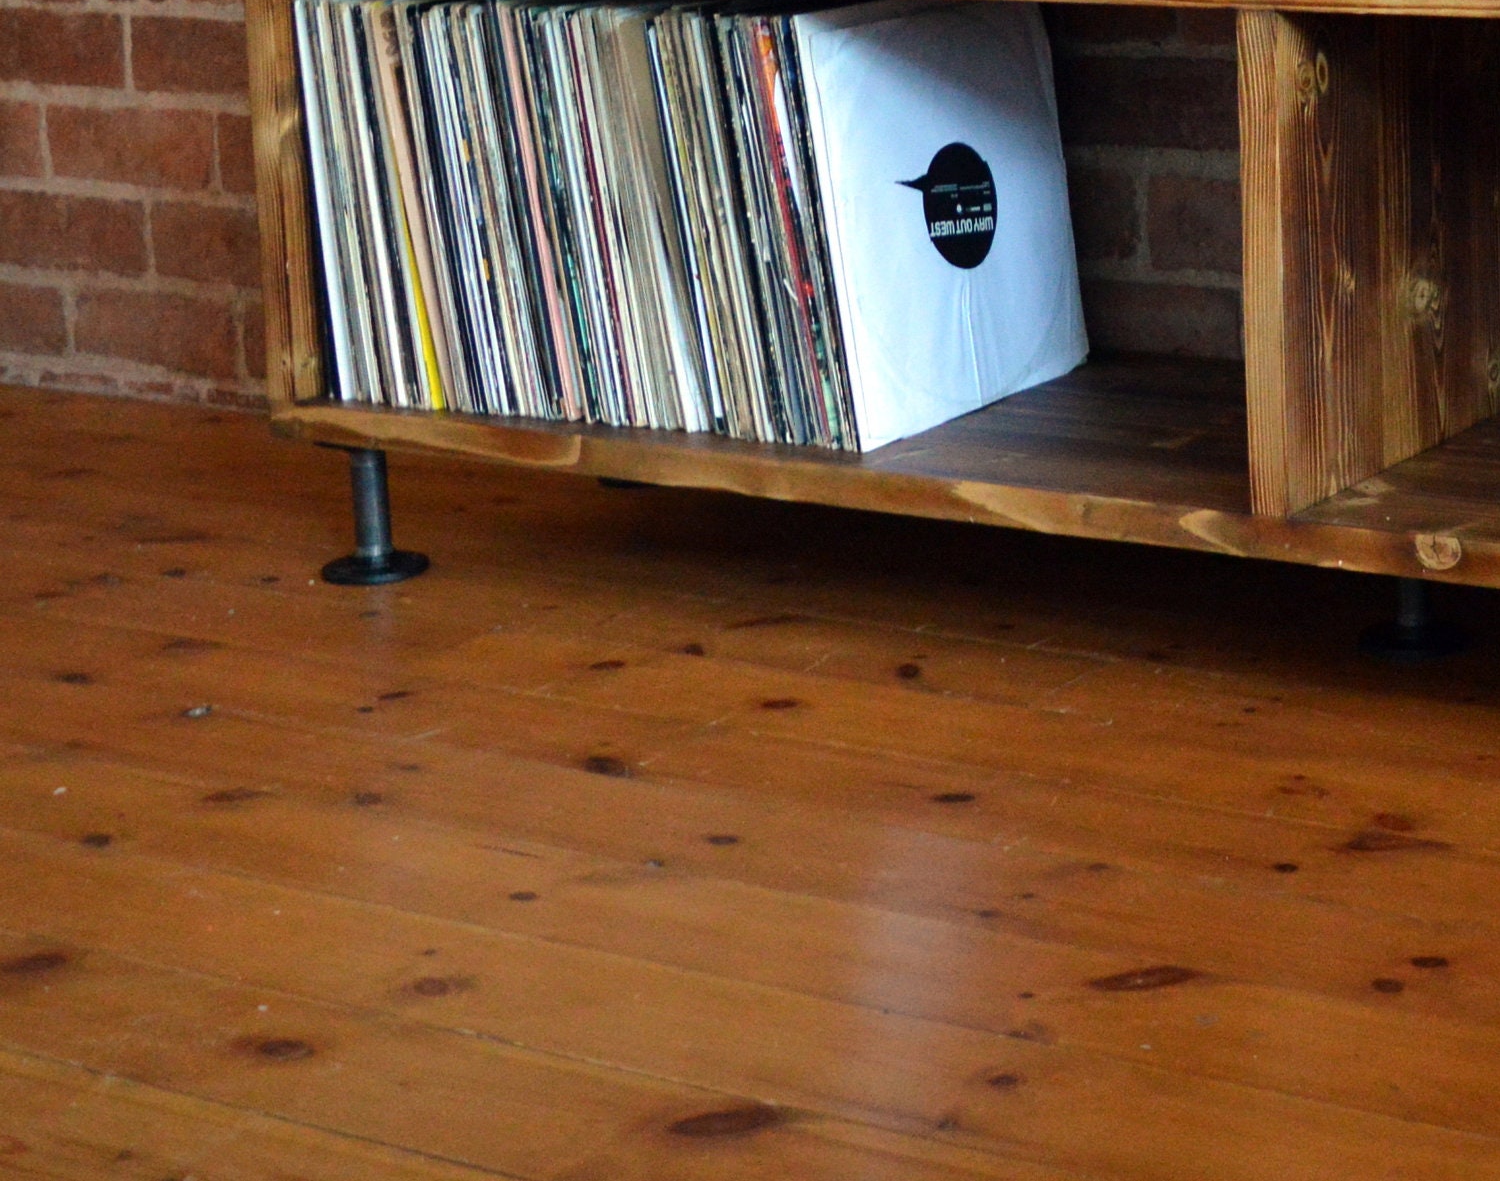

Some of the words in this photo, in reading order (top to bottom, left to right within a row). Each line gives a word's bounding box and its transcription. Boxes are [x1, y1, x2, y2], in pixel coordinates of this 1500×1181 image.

[930, 220, 955, 237] WEST
[956, 218, 973, 234] OUT
[973, 216, 994, 232] WAY
